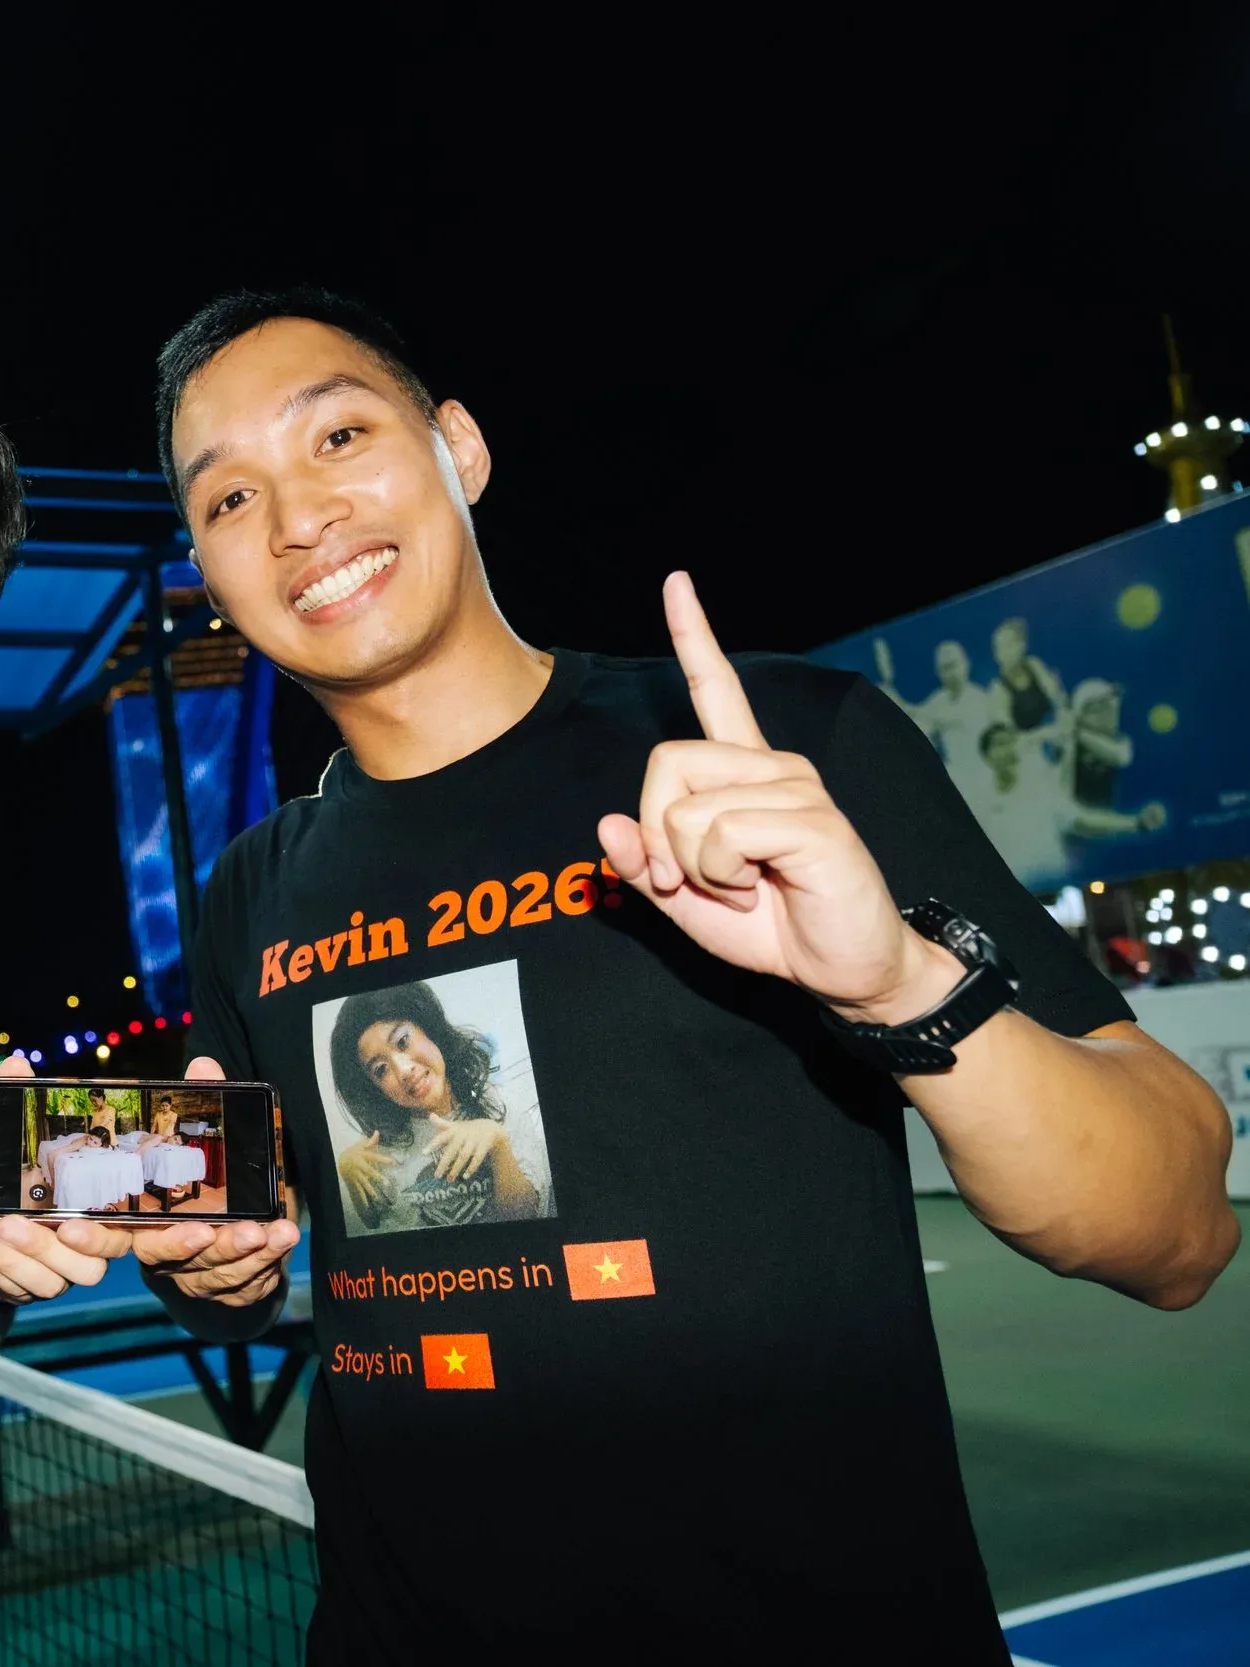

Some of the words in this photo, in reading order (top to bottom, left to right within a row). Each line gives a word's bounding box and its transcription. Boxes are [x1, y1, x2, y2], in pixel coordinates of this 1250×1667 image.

[258, 911, 409, 998] Kevin
[427, 857, 623, 948] 2026!
[328, 1266, 375, 1301] What
[381, 1266, 514, 1303] happens
[520, 1256, 553, 1288] in
[331, 1343, 384, 1382] Stays
[388, 1345, 414, 1375] in
